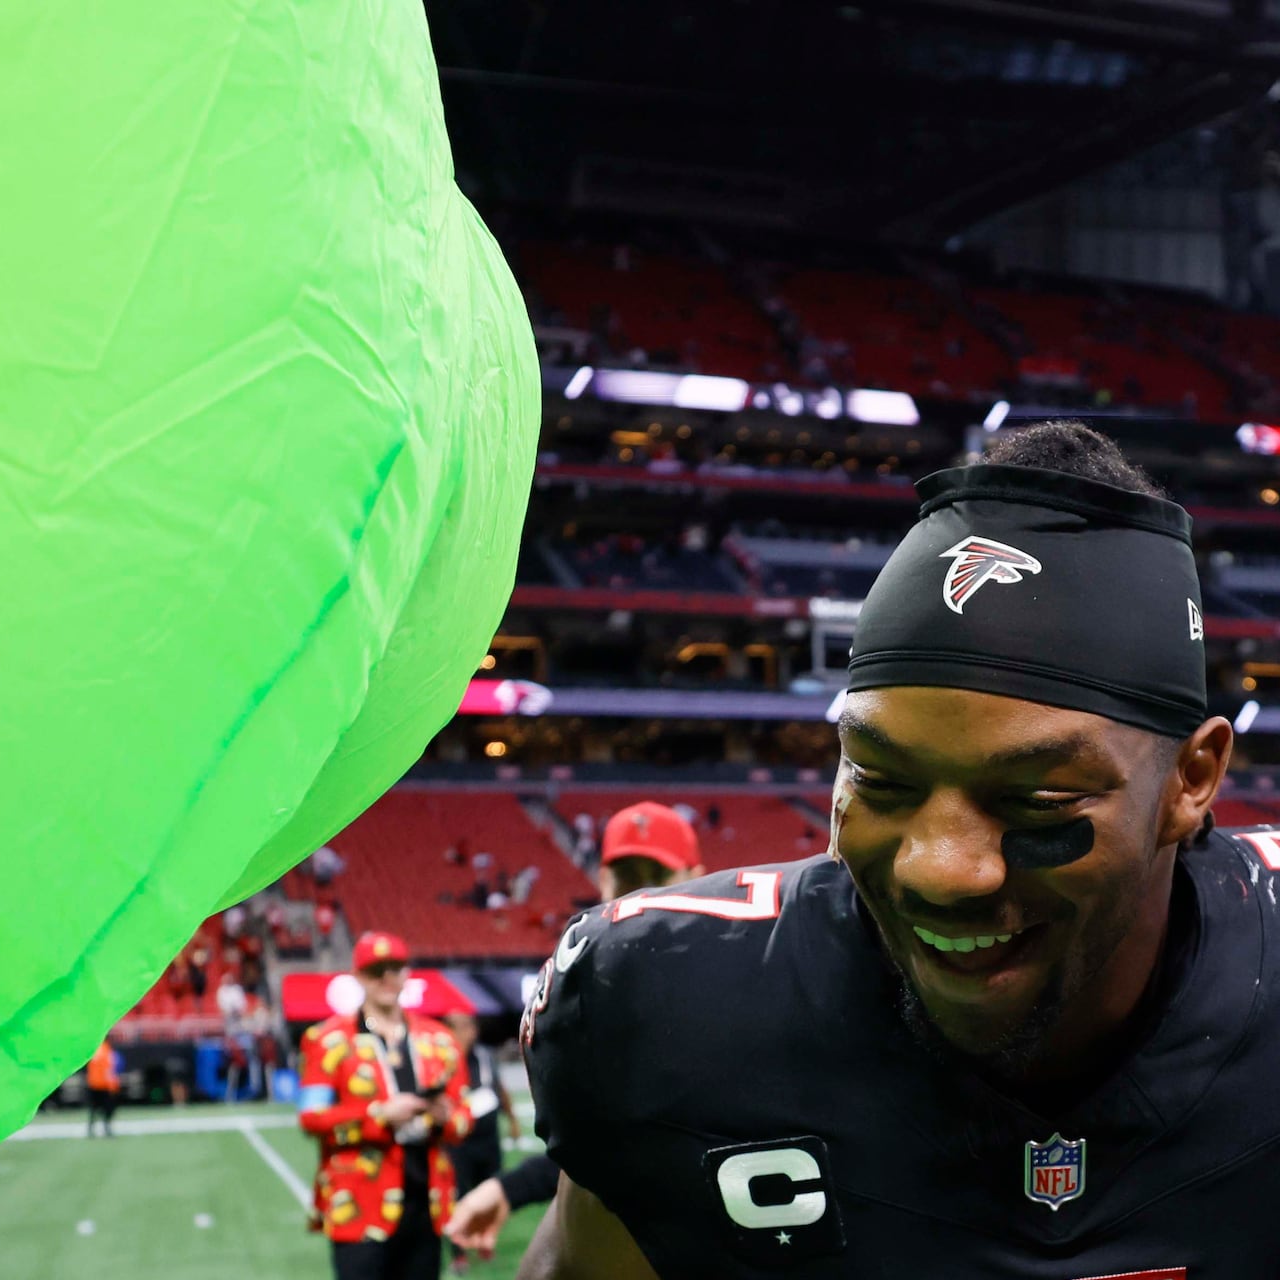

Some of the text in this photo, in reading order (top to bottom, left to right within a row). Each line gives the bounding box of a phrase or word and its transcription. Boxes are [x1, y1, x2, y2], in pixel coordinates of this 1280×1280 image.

[611, 870, 783, 922] 7
[717, 1147, 827, 1230] C
[1035, 1168, 1076, 1196] NFL
